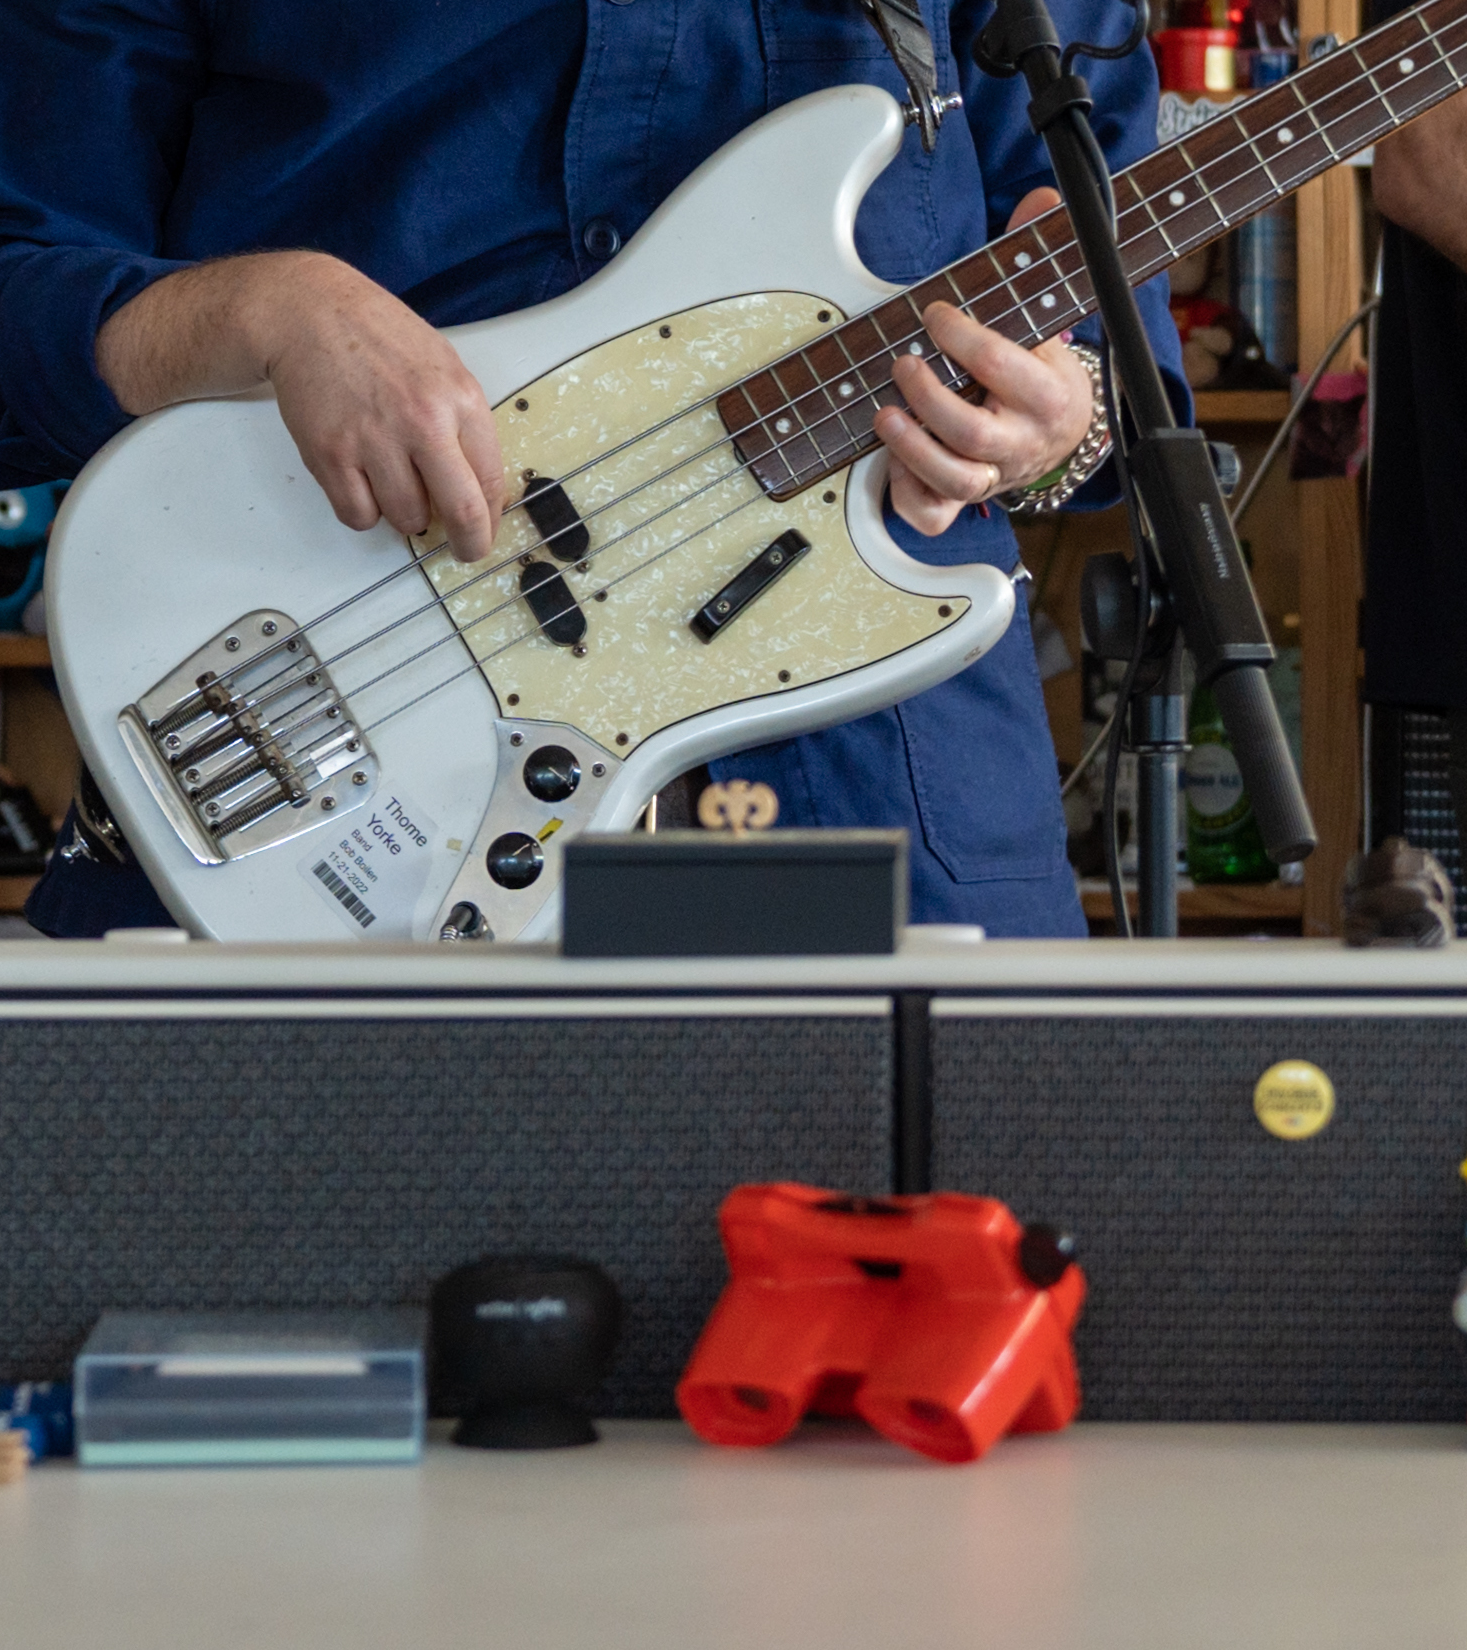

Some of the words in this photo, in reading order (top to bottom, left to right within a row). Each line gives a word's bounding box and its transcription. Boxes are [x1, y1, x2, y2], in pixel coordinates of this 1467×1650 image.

[350, 828, 374, 853] Band
[365, 812, 403, 857] Yorke
[327, 850, 370, 896] 11-21-2022
[339, 839, 357, 859] Bob
[353, 855, 379, 883] Boilen
